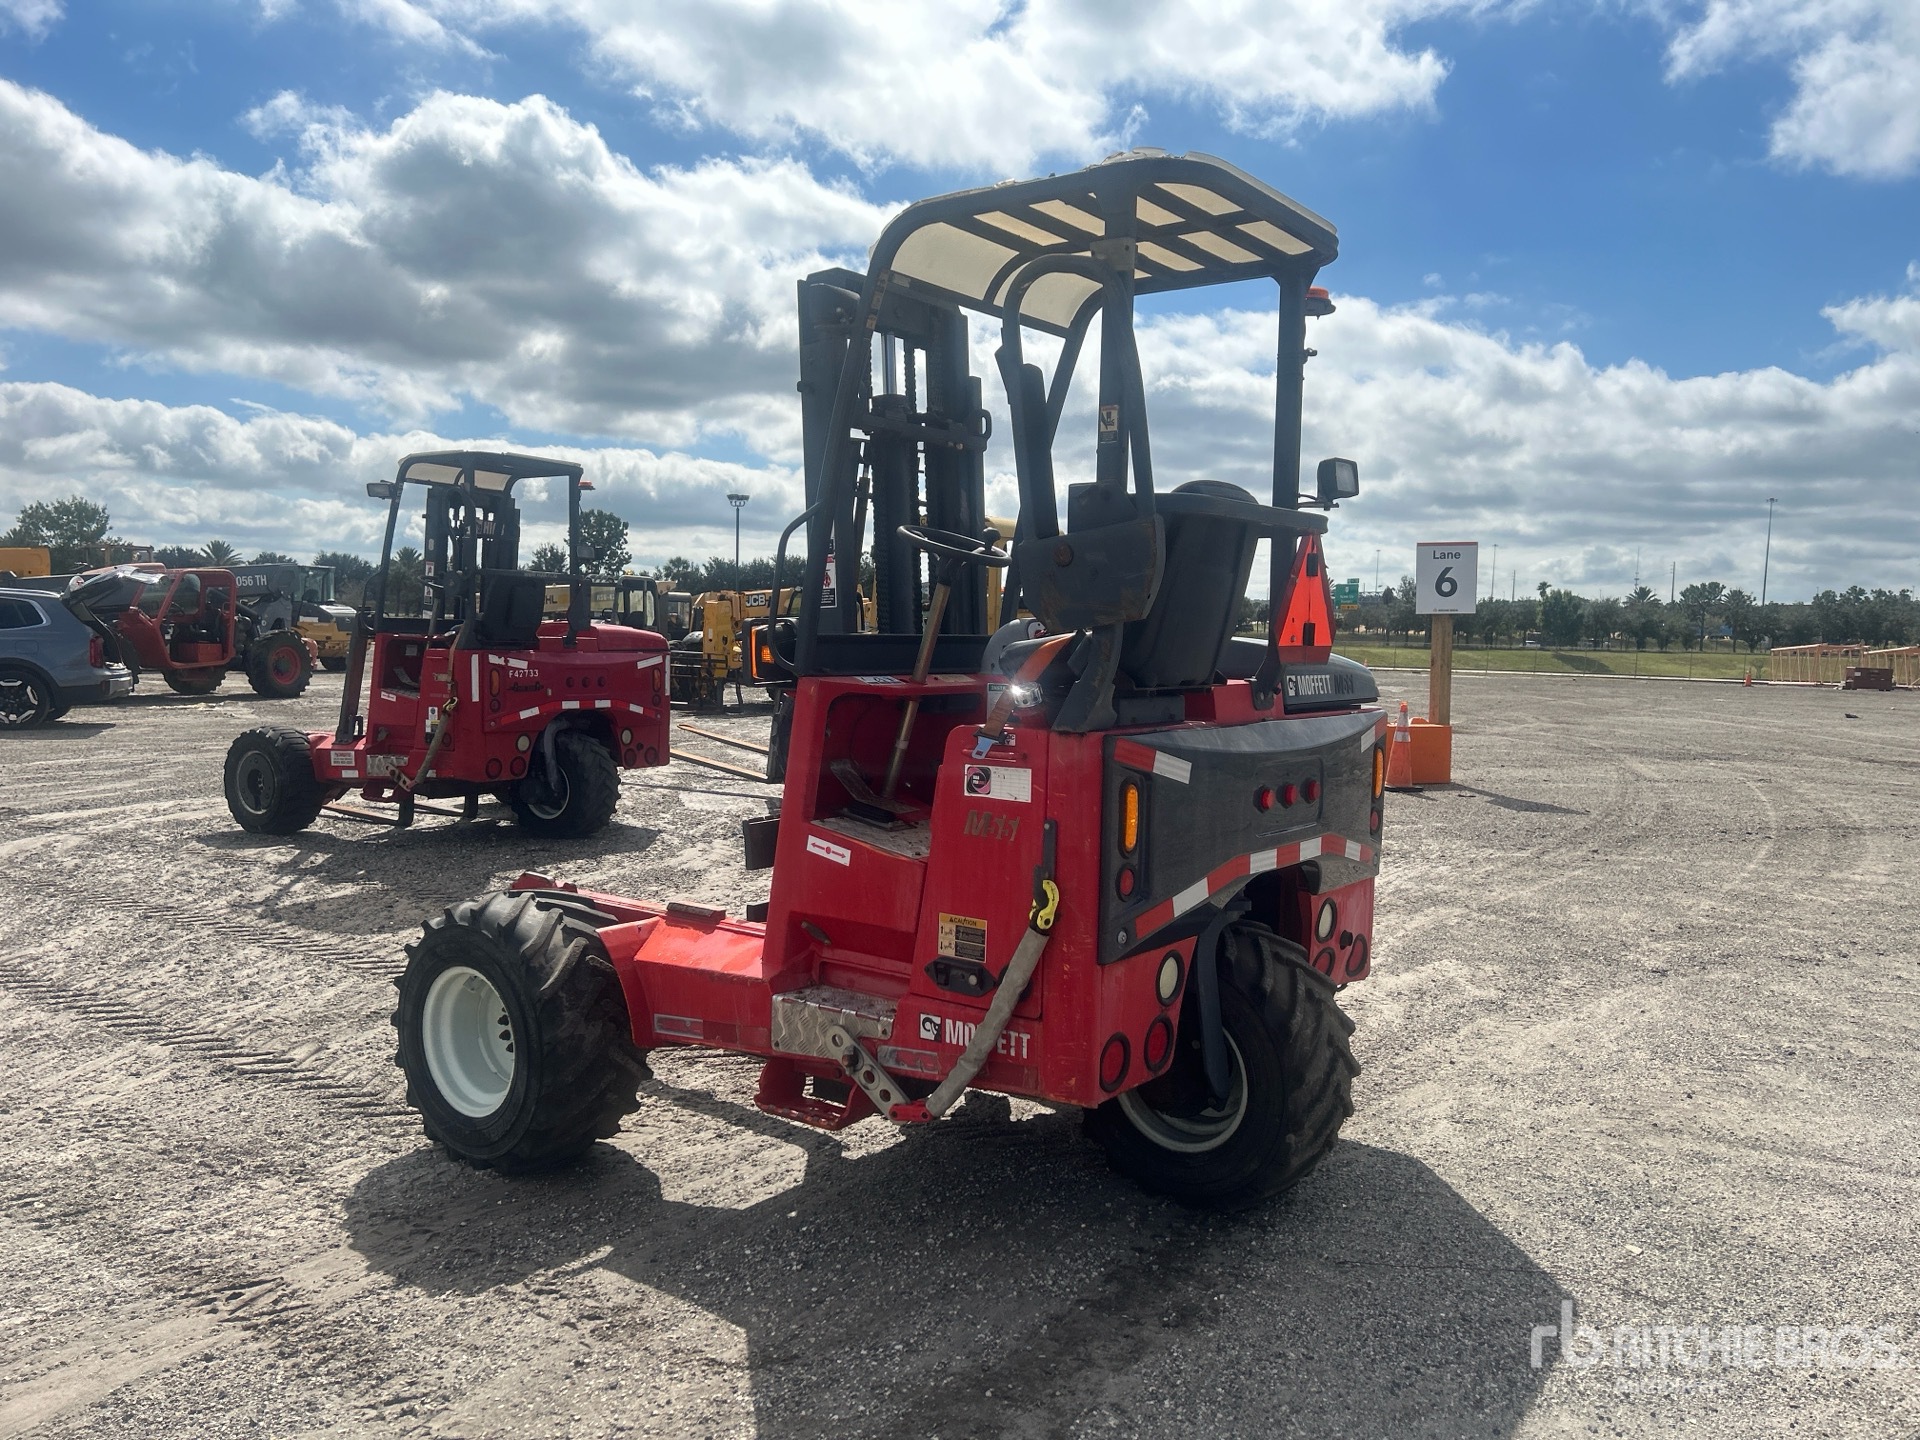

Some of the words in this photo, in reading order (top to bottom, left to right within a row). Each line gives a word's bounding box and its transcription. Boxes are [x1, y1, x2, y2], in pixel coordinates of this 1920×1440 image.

[1433, 550, 1461, 560] Lane
[236, 576, 253, 587] 056
[255, 574, 267, 586] TH
[1435, 566, 1458, 598] 6
[545, 594, 558, 605] HL
[745, 594, 766, 607] JCB
[508, 669, 539, 678] F42733
[1297, 674, 1332, 696] MOFFETT
[953, 917, 977, 927] CAUTION
[945, 1018, 1031, 1059] MOETT
